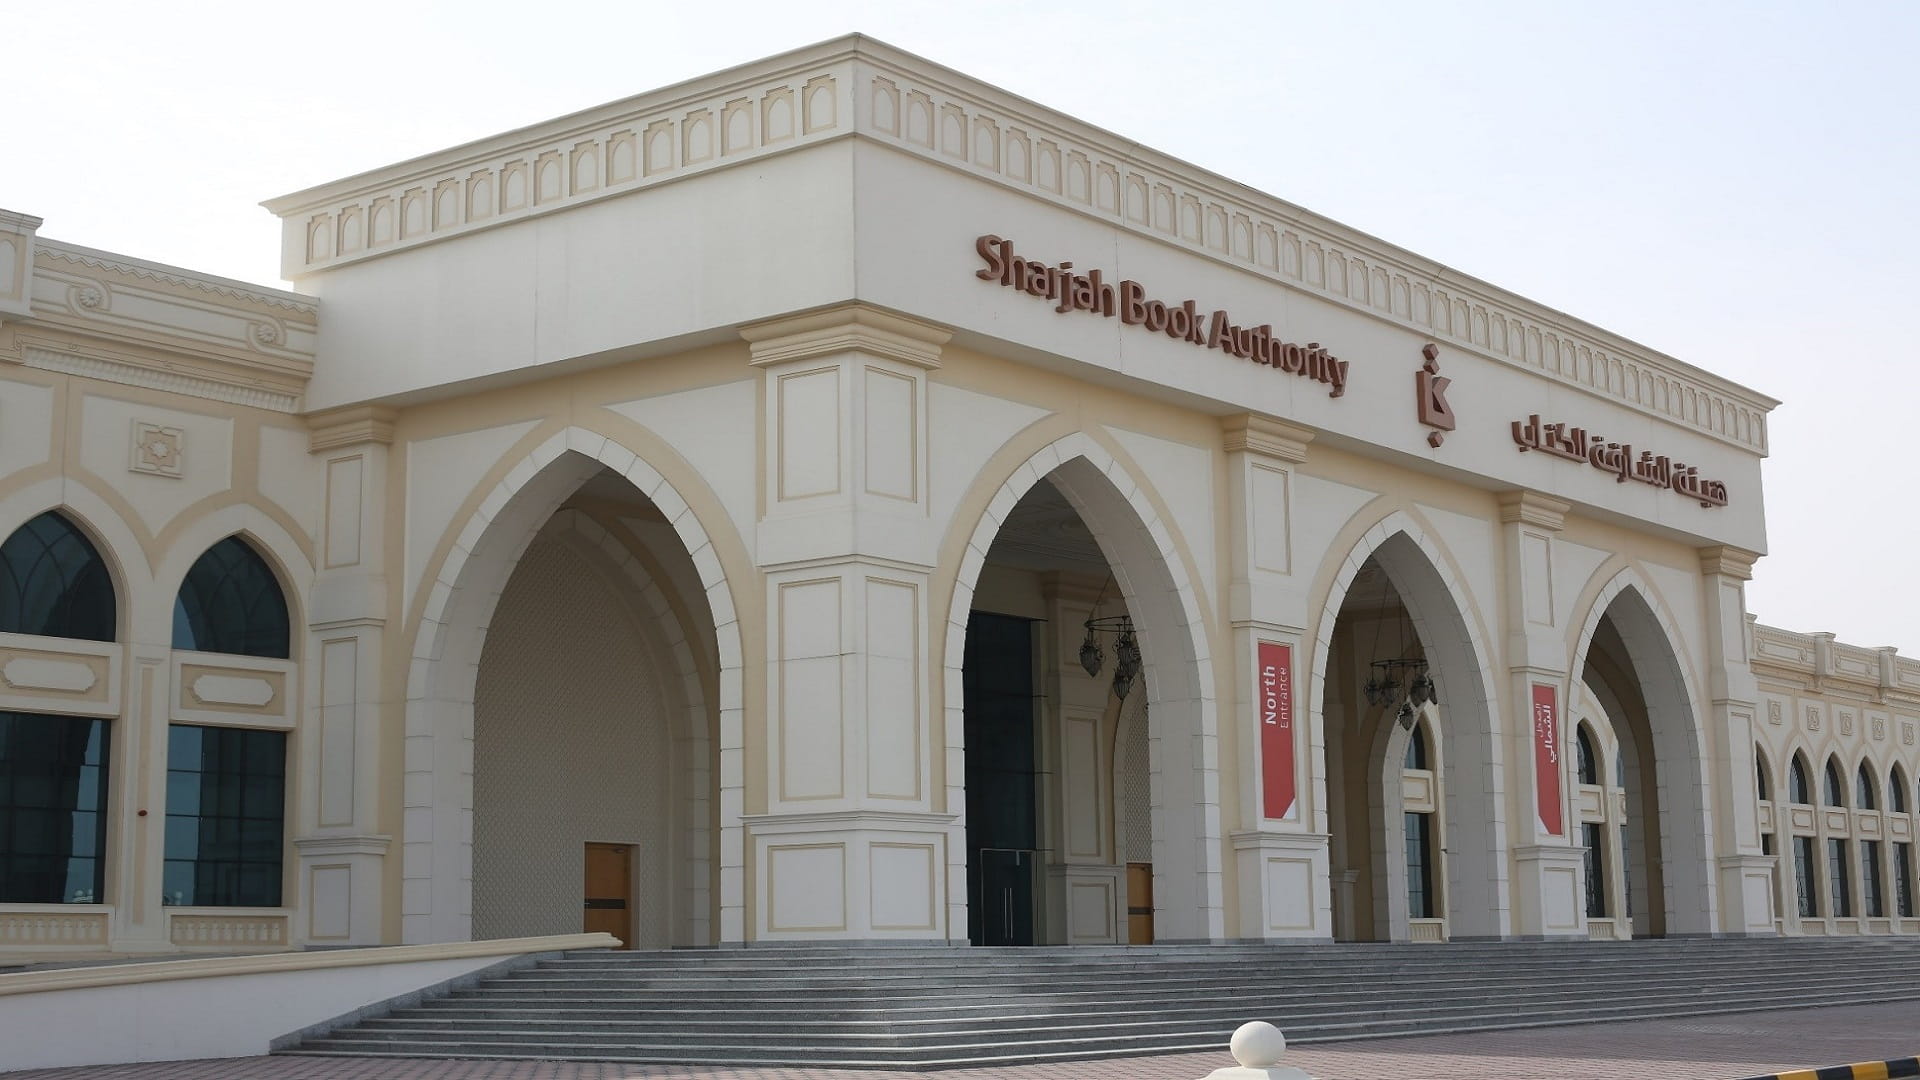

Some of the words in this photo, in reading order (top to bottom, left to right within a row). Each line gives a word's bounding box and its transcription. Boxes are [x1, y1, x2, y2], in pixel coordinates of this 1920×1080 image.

[976, 234, 1115, 317] Sharjah
[1120, 279, 1207, 345] Book
[1208, 310, 1350, 398] Authority
[1511, 414, 1588, 463] للكتاب
[1589, 436, 1670, 489] الشارقة
[1672, 463, 1728, 508] هيئة
[1264, 666, 1277, 725] North
[1279, 667, 1289, 729] Entrance
[1542, 704, 1557, 763] الشمالي
